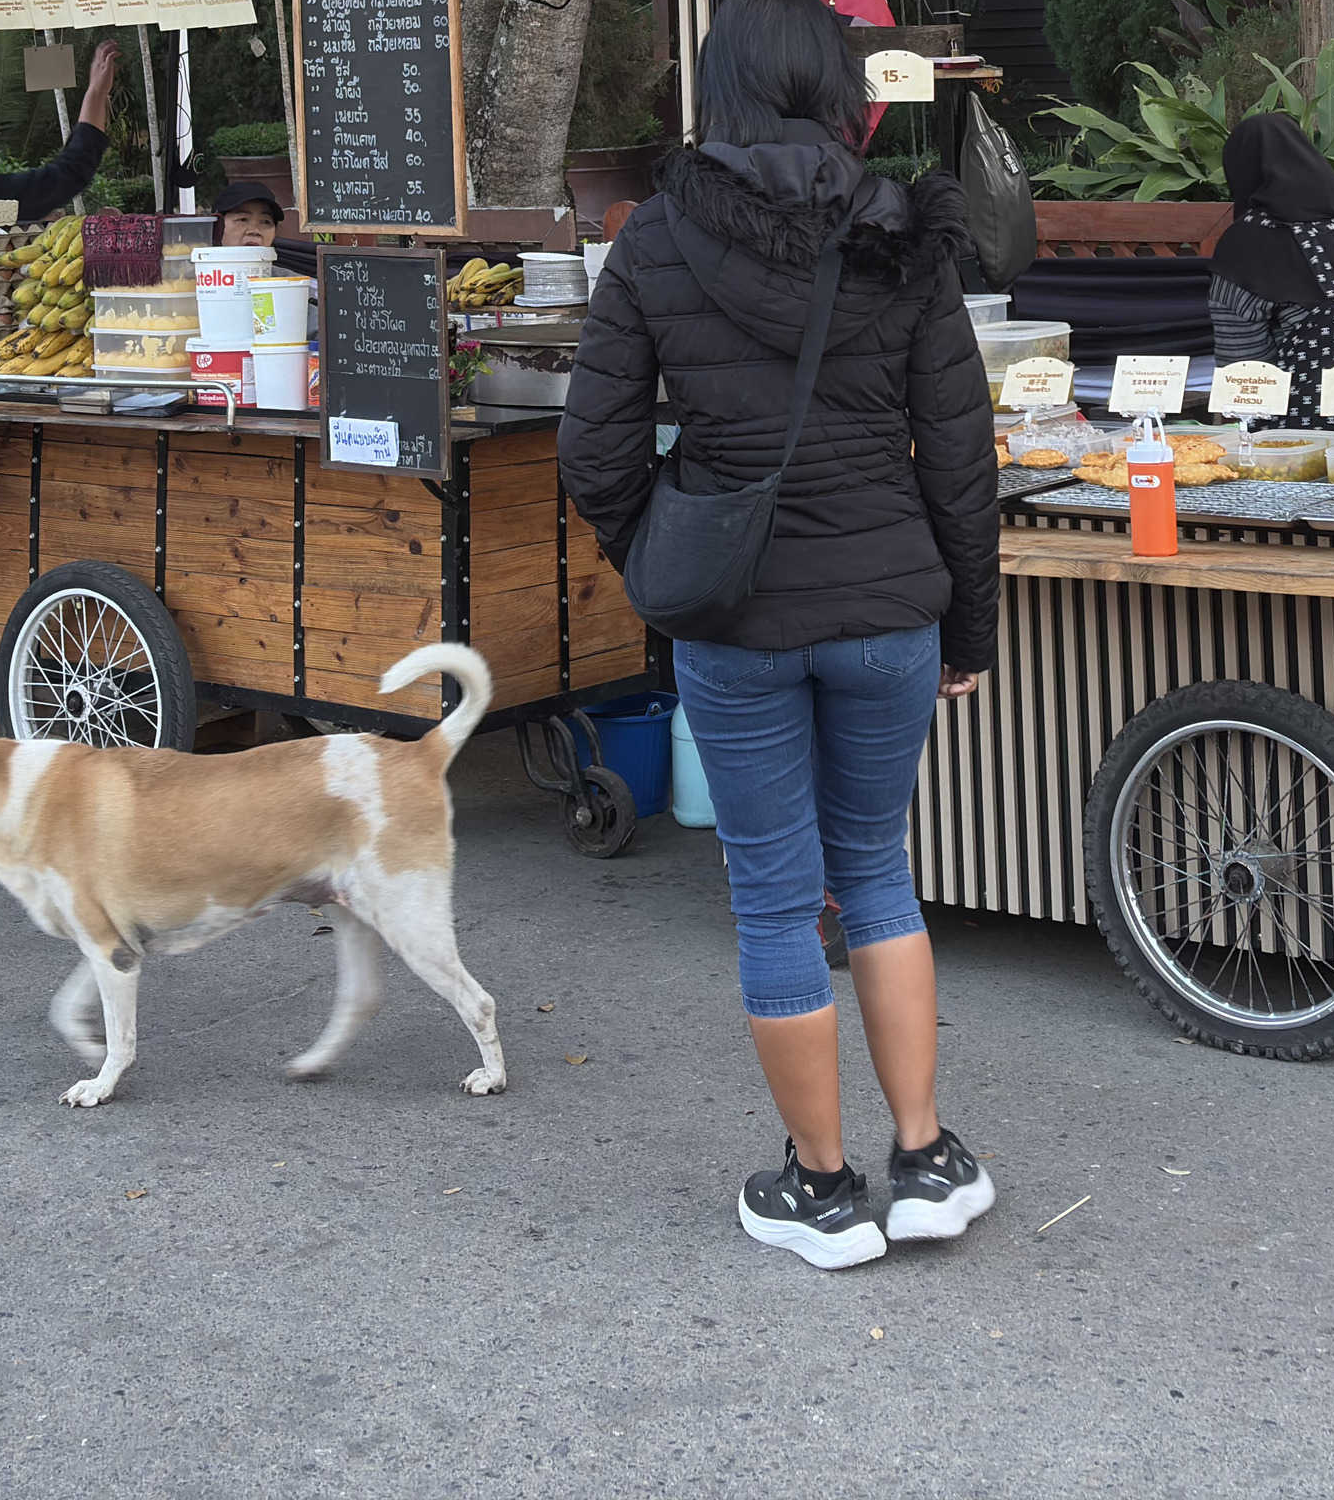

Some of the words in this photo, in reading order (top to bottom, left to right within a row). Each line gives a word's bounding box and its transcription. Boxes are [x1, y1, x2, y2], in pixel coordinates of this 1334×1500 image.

[882, 70, 909, 83] 15.-
[1225, 375, 1277, 386] Vegetables
[1234, 395, 1263, 405] ผักรวม
